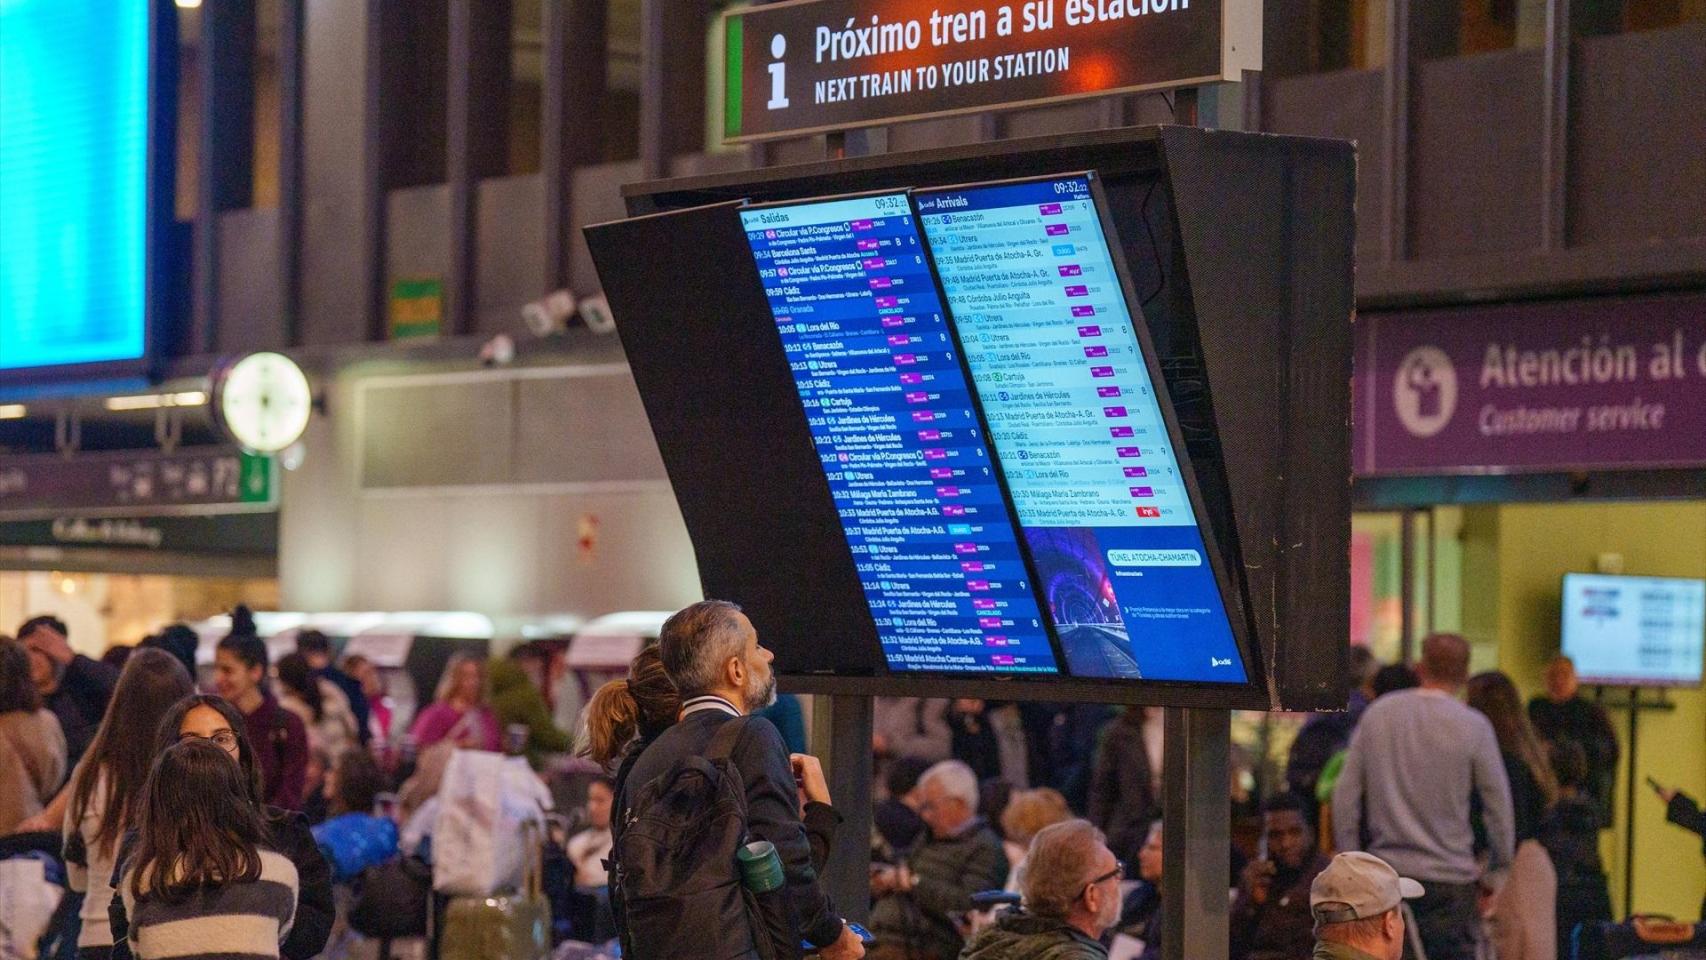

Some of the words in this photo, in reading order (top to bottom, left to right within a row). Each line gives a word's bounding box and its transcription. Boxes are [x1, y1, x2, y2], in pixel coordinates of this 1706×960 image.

[816, 15, 919, 64] Próximo
[929, 6, 989, 49] tren
[997, 8, 1014, 37] a
[1023, 1, 1054, 31] su
[815, 77, 859, 105] NEXT
[860, 72, 912, 100] TRAIN
[916, 70, 937, 91] TO
[941, 61, 989, 89] YOUR
[994, 46, 1070, 80] STATION
[935, 195, 968, 208] Arrivals
[760, 212, 790, 224] Salidas
[776, 228, 799, 236] Circular
[808, 223, 844, 235] P.Congresos
[959, 233, 978, 242] Utrera
[772, 247, 800, 257] Barcelona
[800, 246, 817, 254] Sants
[909, 236, 915, 244] 6
[953, 254, 975, 263] Madrid
[975, 252, 994, 262] Puerta
[994, 252, 1003, 260] de
[760, 269, 777, 277] 09:57
[788, 266, 811, 274] Circular
[820, 261, 856, 274] P.Congresos
[960, 274, 981, 283] Madrid
[981, 272, 1000, 281] Puerta
[1000, 271, 1009, 279] de
[992, 292, 1006, 300] Julio
[1006, 291, 1031, 301] Anguita
[984, 313, 1003, 321] Utrera
[778, 325, 795, 333] 10:05
[806, 323, 820, 331] Lora
[820, 322, 830, 330] del
[990, 333, 1009, 341] Utrera
[1121, 325, 1127, 333] 8
[784, 344, 802, 352] 10:12
[940, 333, 946, 341] 8
[818, 360, 837, 368] Utrera
[946, 352, 952, 360] 9
[1010, 352, 1021, 360] del
[1479, 335, 1637, 390] Atención
[1650, 326, 1685, 379] al
[1004, 372, 1026, 382] Cartuja
[1009, 392, 1034, 400] Jardines
[830, 397, 853, 407] Cartuja
[836, 416, 861, 424] Jardines
[1004, 412, 1026, 420] Madrid
[1026, 411, 1045, 419] Puerta
[1478, 404, 1580, 436] Customer
[1587, 398, 1665, 432] service
[814, 436, 832, 444] 10:22
[971, 429, 977, 437] 9
[820, 454, 838, 462] 10:27
[848, 453, 872, 461] Circular
[977, 448, 982, 456] 8
[887, 489, 917, 497] Zambrano
[856, 508, 877, 516] Madrid
[1058, 509, 1077, 517] Puerta
[883, 526, 901, 534] Puerta
[903, 618, 917, 626] Lora
[1032, 619, 1038, 627] 8
[919, 636, 937, 644] Puerta
